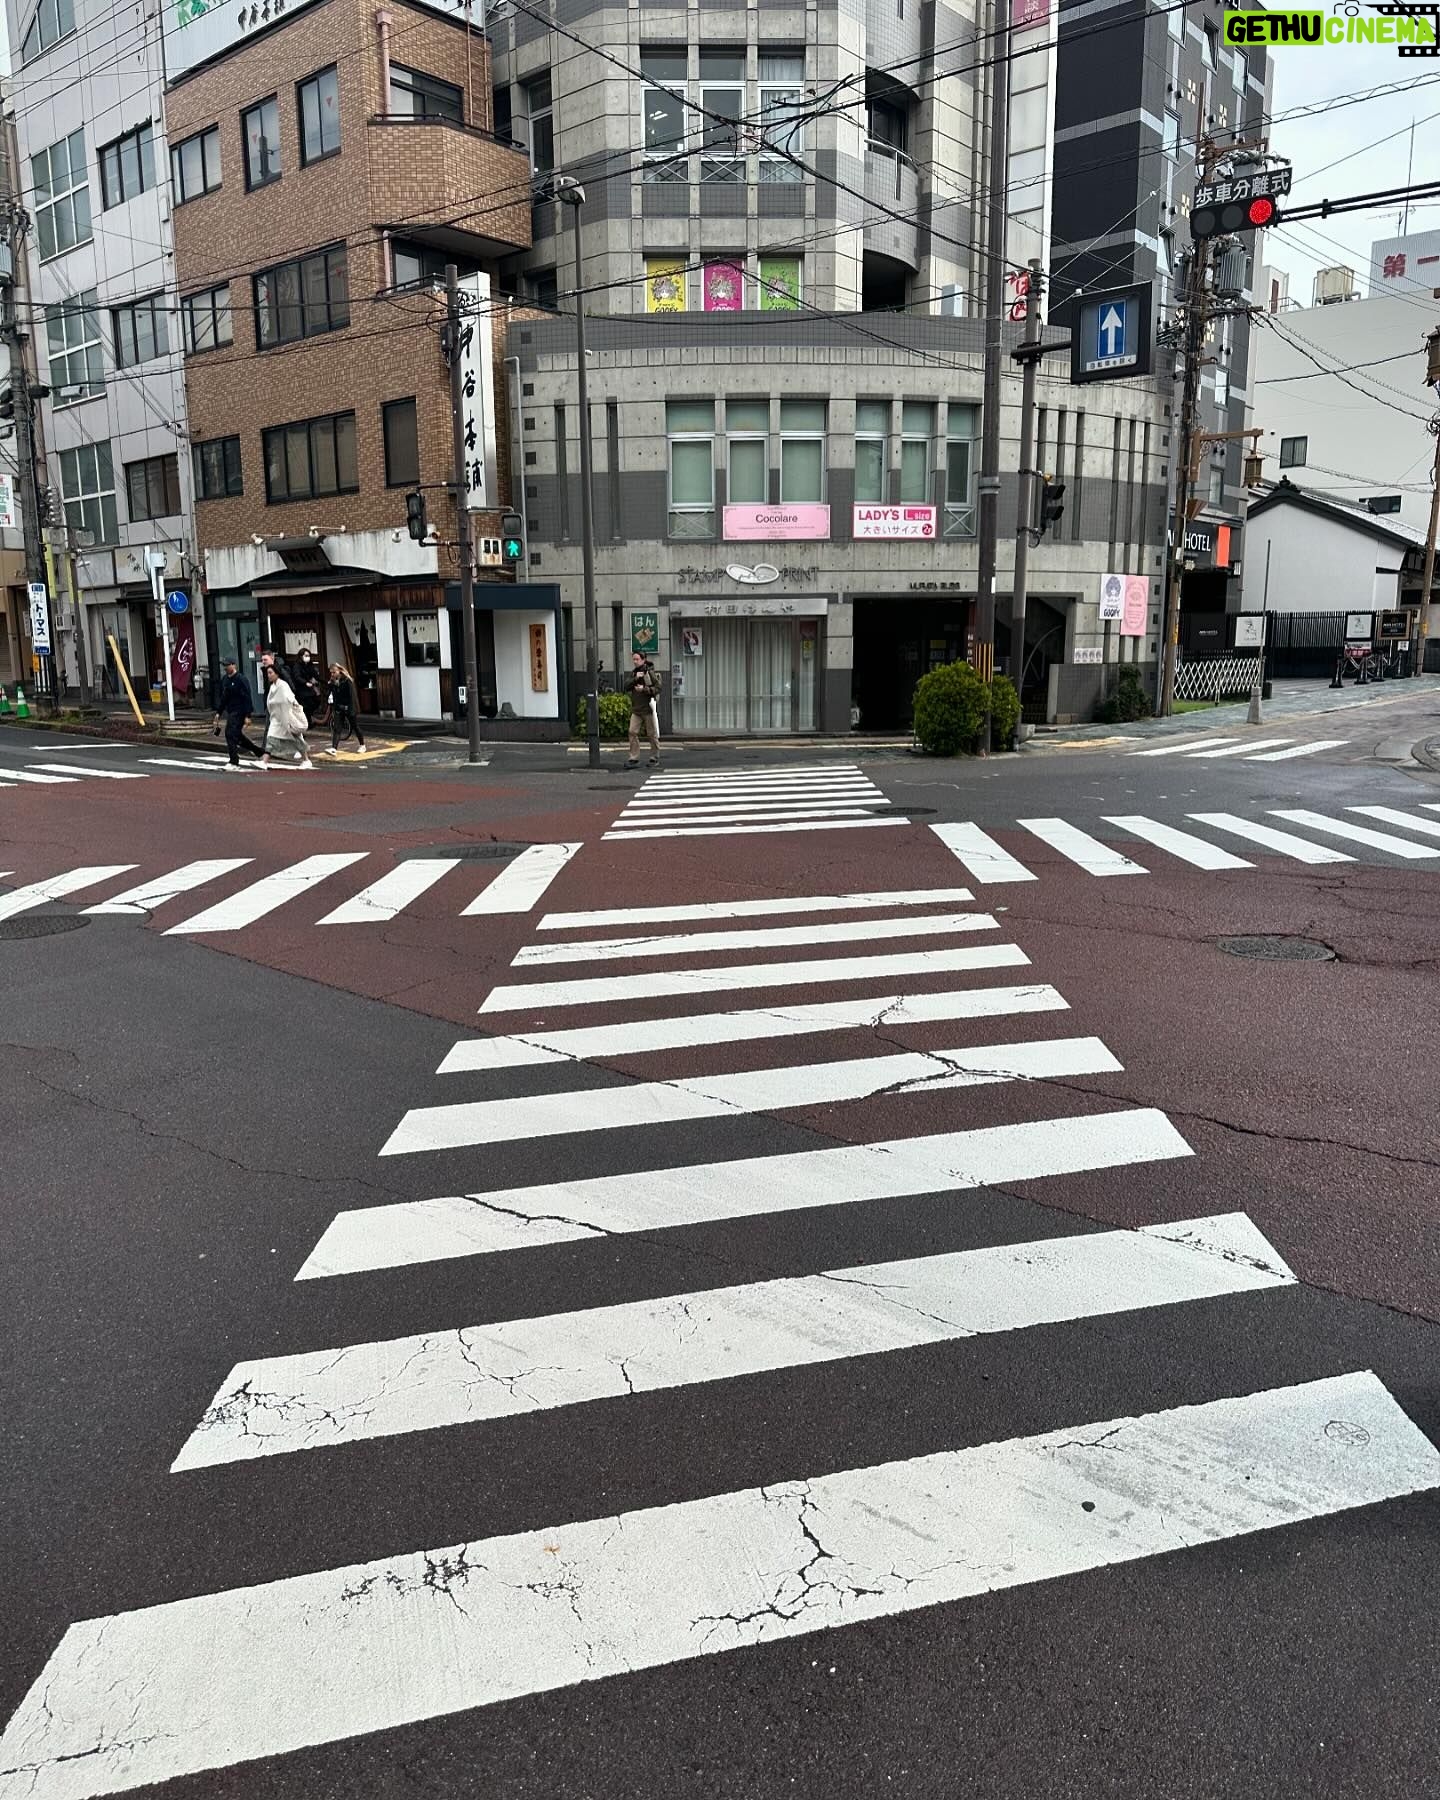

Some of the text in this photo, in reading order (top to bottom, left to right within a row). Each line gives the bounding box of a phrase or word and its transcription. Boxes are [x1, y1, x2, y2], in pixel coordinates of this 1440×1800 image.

[1195, 171, 1290, 208] 歩車分離式
[1382, 252, 1440, 278] 第一
[755, 513, 798, 523] Cocolare
[858, 508, 900, 520] LADY'S
[863, 525, 919, 535] 大きいサイズ
[1184, 532, 1211, 552] HOTEL
[781, 566, 819, 583] PRINT
[634, 616, 655, 627] はん
